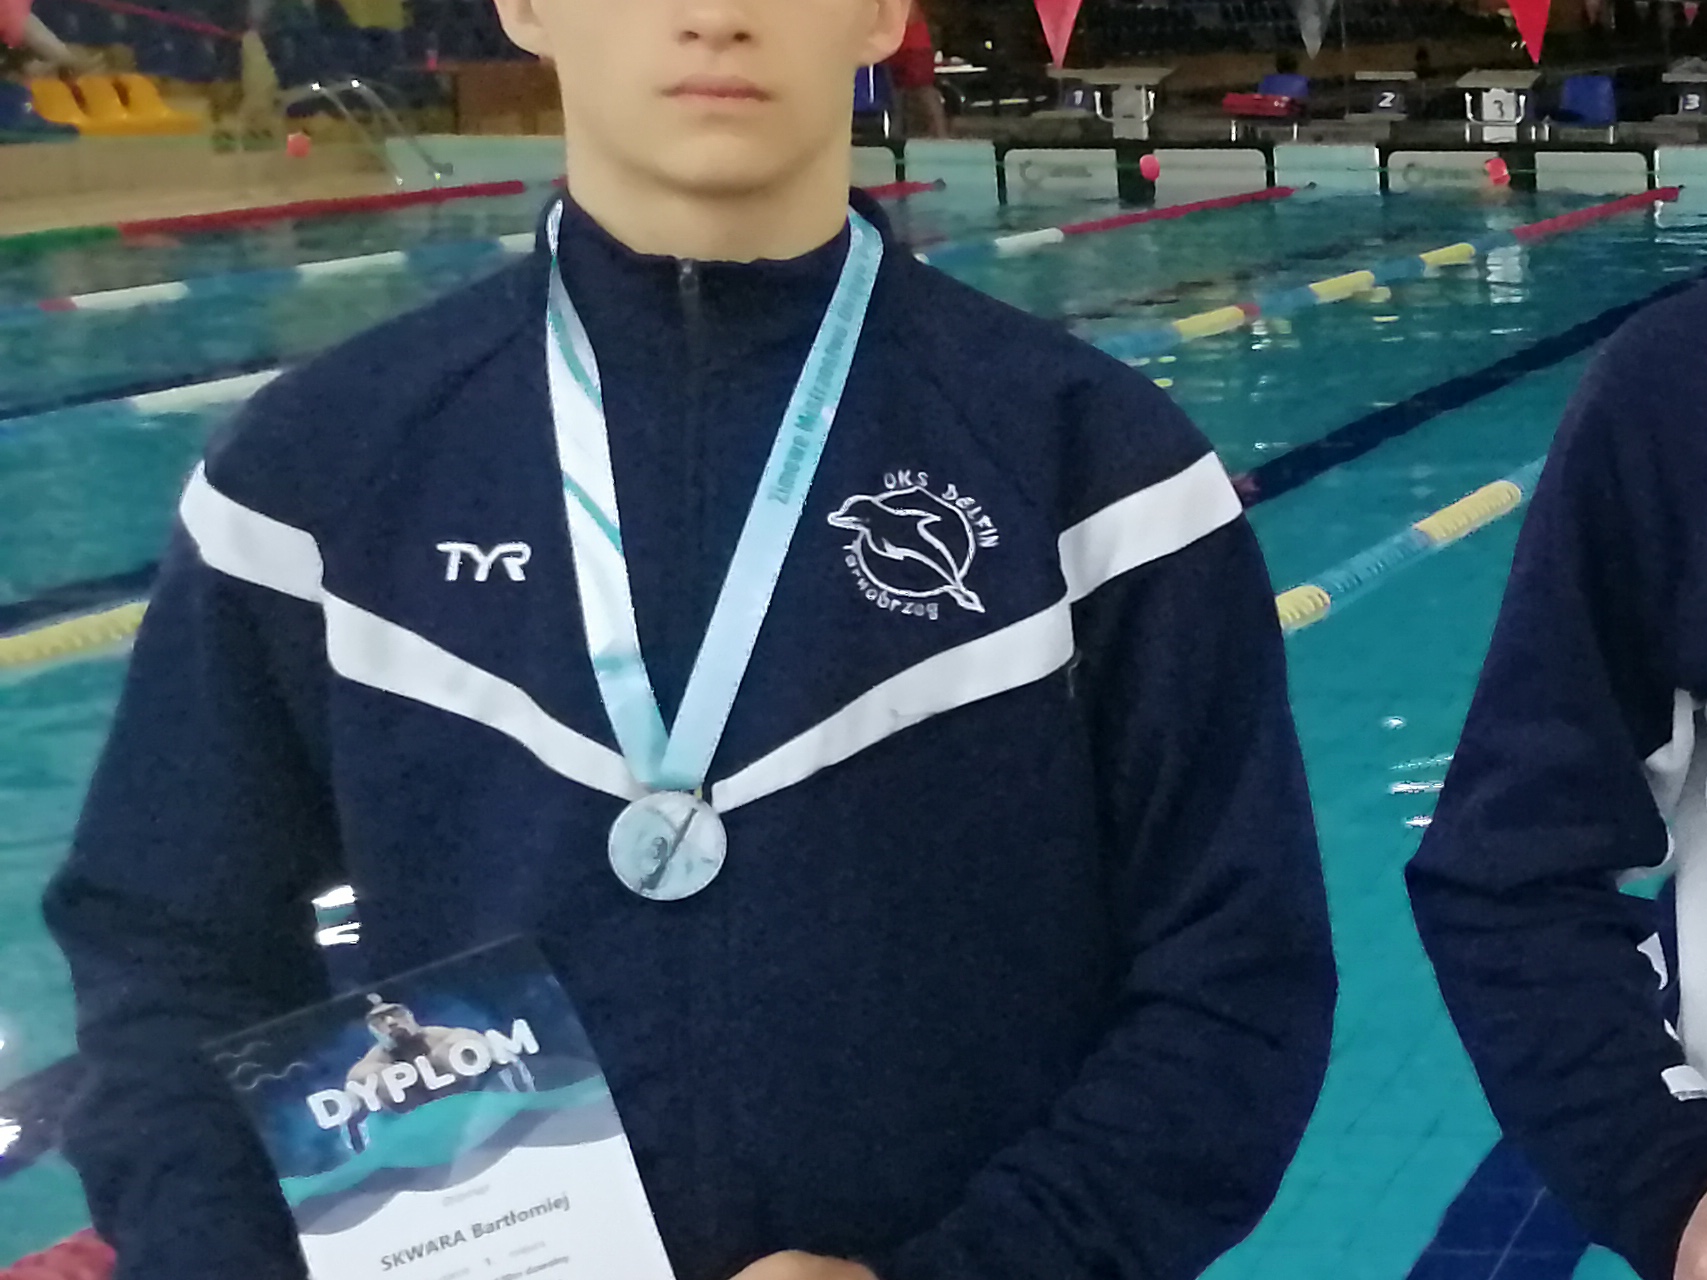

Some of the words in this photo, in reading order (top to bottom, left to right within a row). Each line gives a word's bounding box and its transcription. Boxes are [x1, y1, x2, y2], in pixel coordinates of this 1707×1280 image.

[1379, 92, 1396, 108] 2
[437, 542, 532, 581] TYR
[306, 1018, 540, 1130] DYPLOM
[380, 1230, 467, 1271] SKWARA
